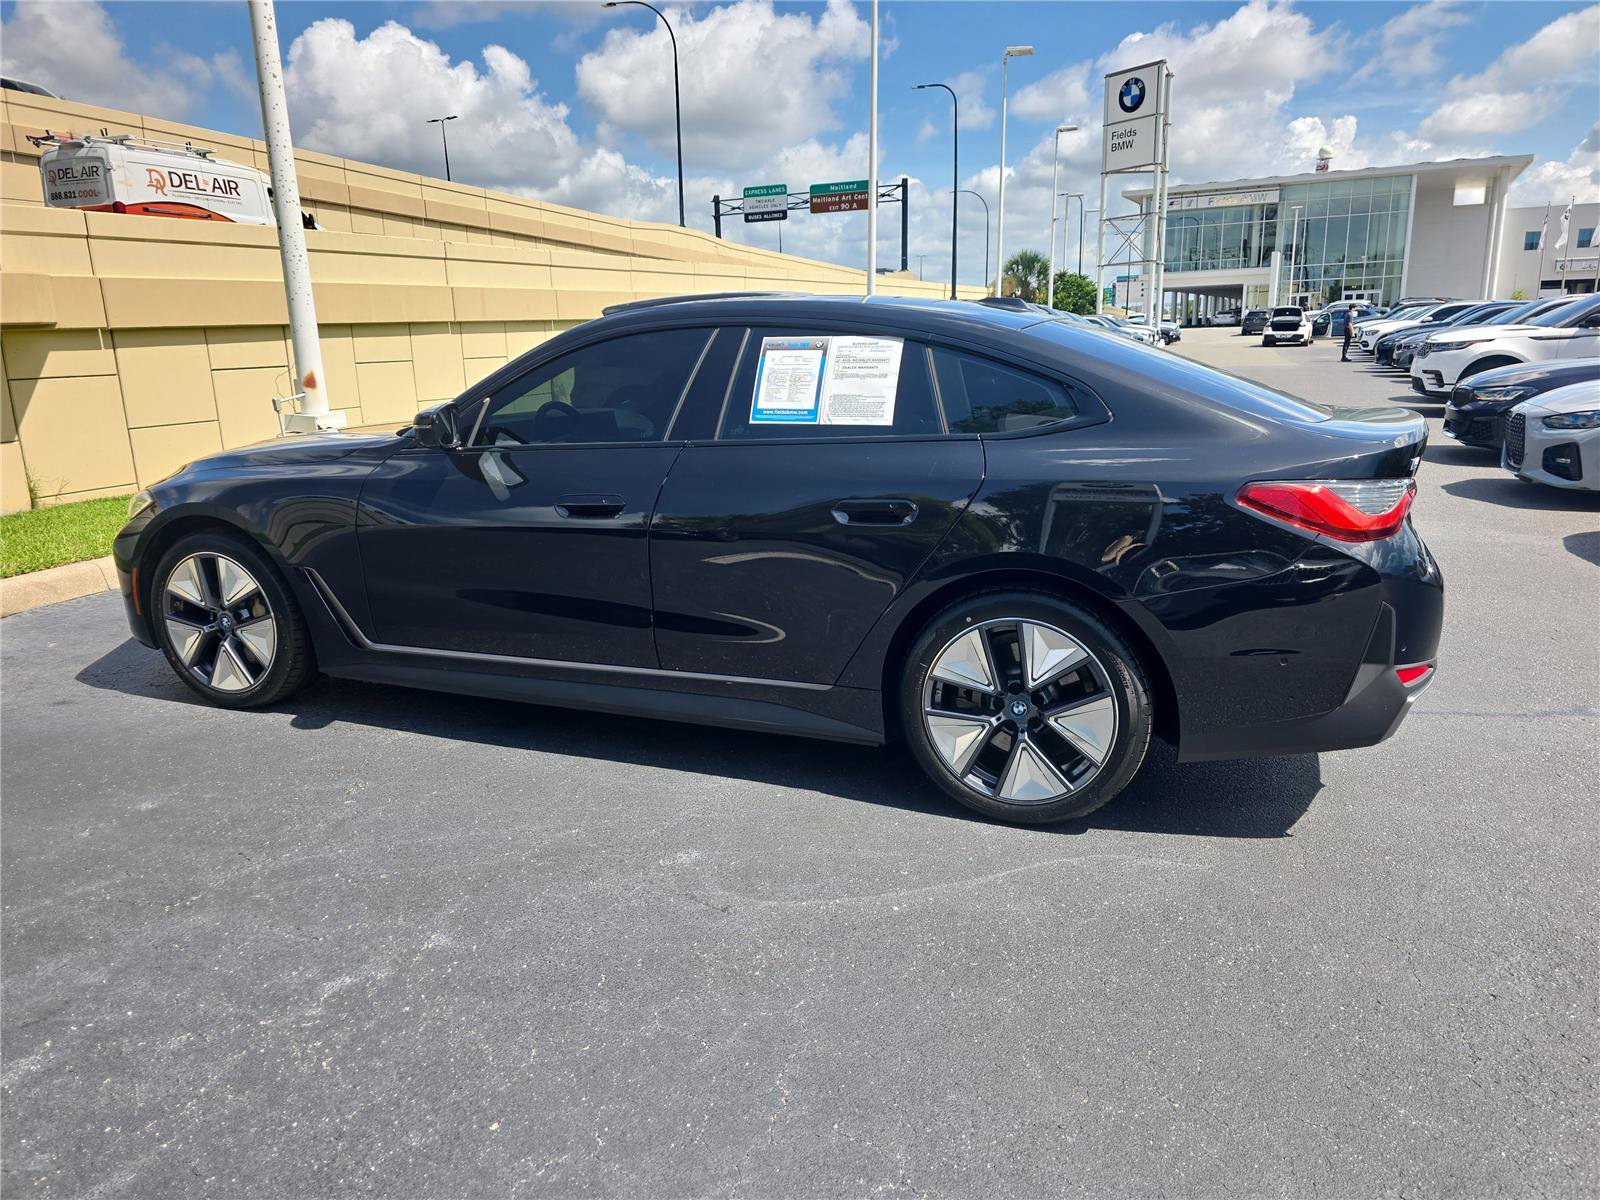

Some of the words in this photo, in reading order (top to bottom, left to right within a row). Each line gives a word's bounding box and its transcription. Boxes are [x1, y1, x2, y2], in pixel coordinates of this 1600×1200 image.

[1111, 128, 1137, 140] Fields
[1111, 139, 1134, 152] BMW
[57, 168, 78, 180] DEL
[80, 165, 100, 178] AIR
[168, 171, 207, 192] DEL
[212, 177, 241, 196] AIR
[830, 183, 857, 191] Maitland
[744, 188, 768, 196] EXPRESS
[812, 195, 840, 203] Maitland
[840, 202, 850, 210] 90
